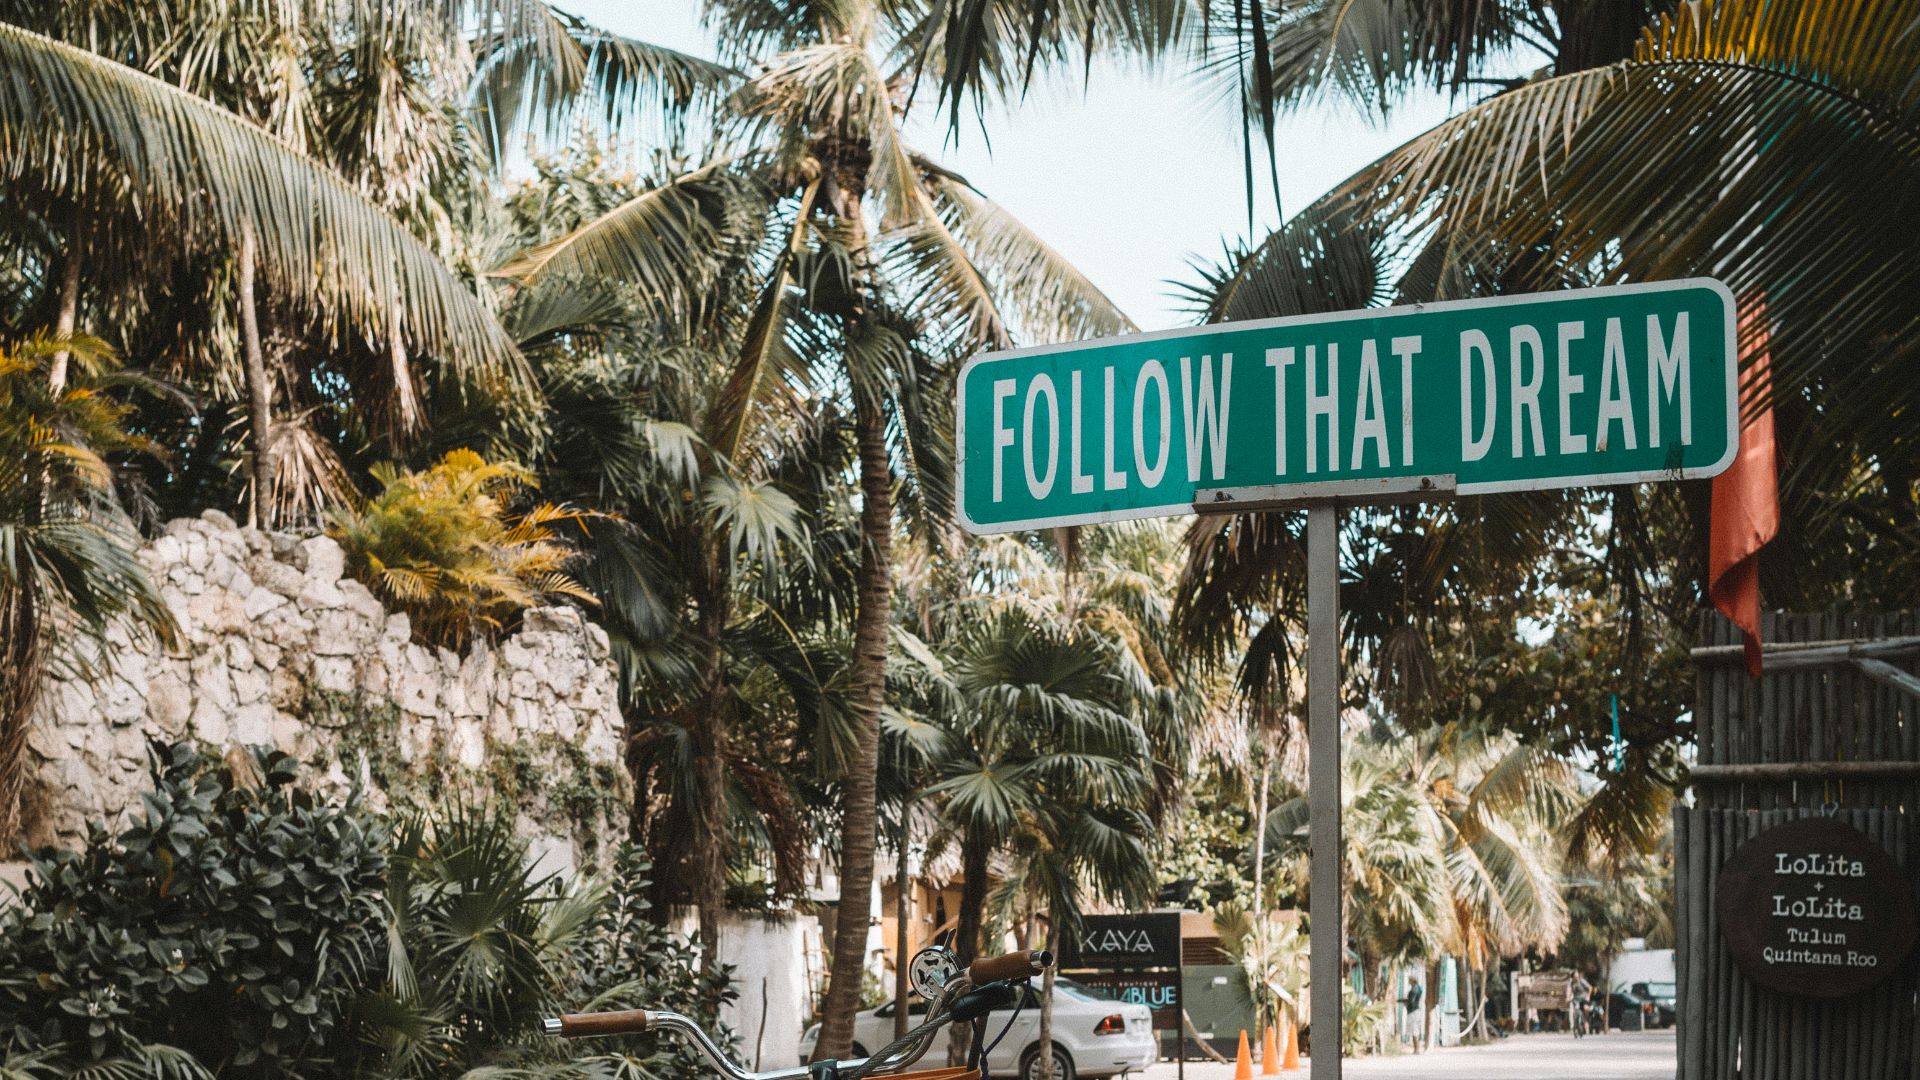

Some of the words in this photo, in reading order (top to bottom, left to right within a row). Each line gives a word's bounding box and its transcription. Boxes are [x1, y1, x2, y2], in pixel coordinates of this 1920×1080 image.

[993, 353, 1233, 503] FOLLOW
[1265, 335, 1422, 476] THAT
[1459, 311, 1692, 462] DREAM
[1775, 853, 1865, 877] LoLita
[1772, 895, 1864, 920] LoLita
[1078, 928, 1155, 953] KAYA
[1787, 928, 1846, 945] Tulum
[1763, 946, 1842, 965] Quintana
[1847, 951, 1877, 967] Roo
